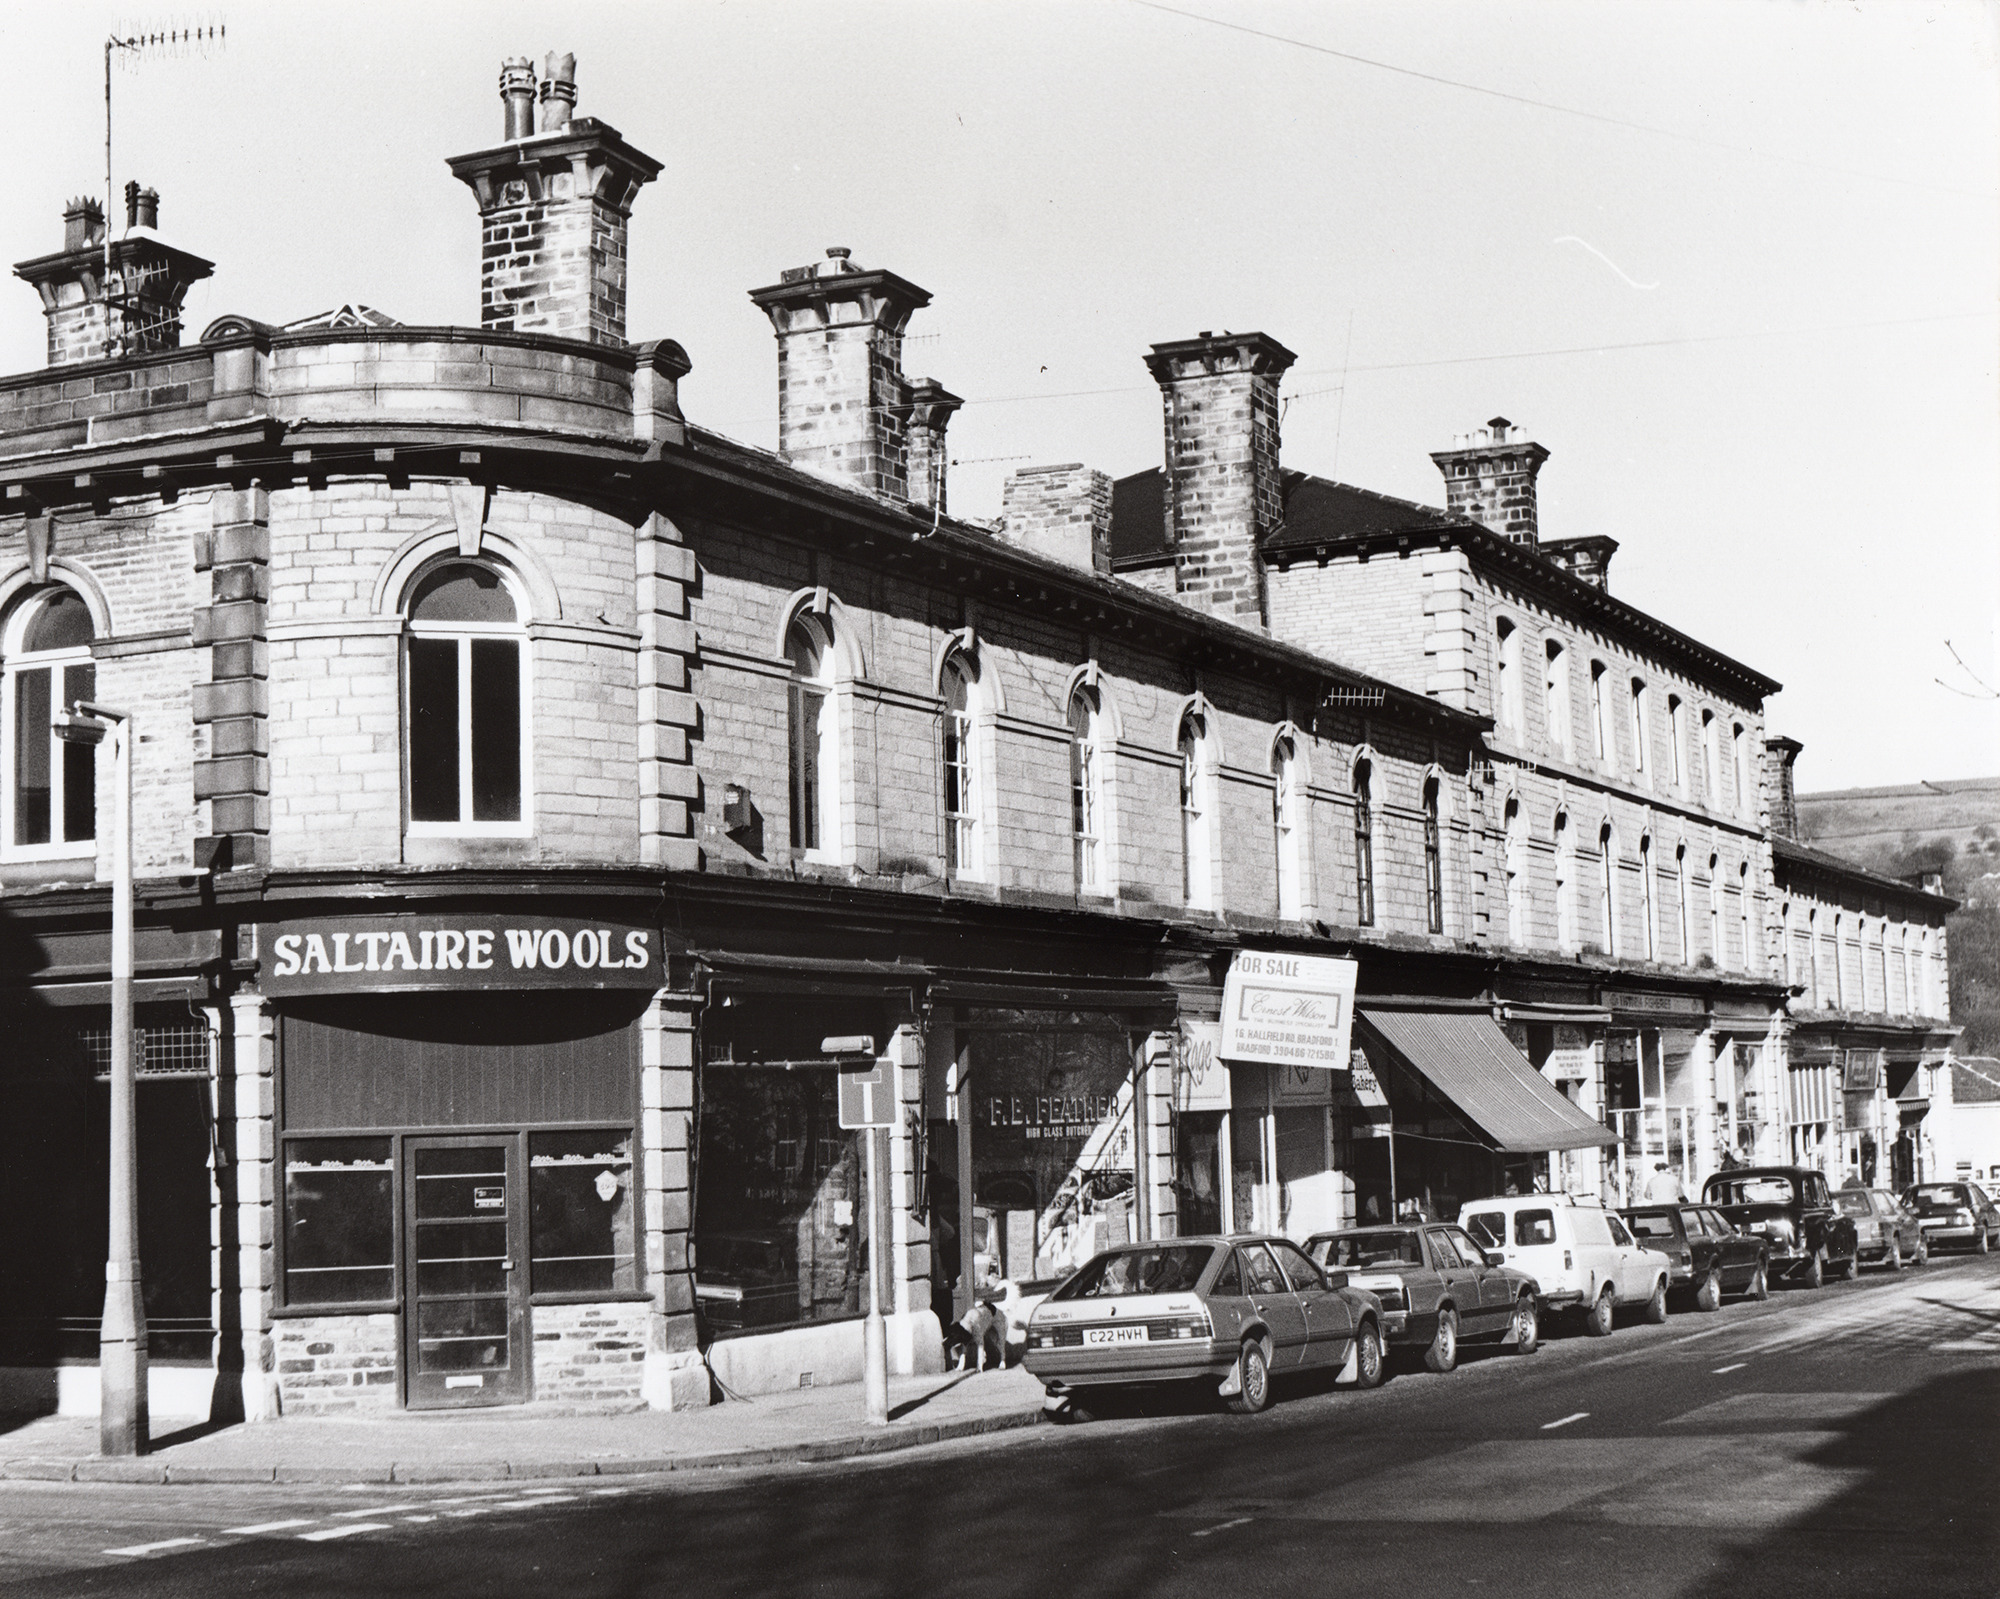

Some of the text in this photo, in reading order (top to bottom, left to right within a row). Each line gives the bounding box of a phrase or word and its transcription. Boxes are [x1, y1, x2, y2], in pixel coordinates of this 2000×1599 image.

[274, 928, 649, 977] SALTAIRE WOOLS
[1234, 956, 1262, 974] FOR
[1266, 958, 1300, 978] SALE
[1250, 993, 1327, 1020] Ernest Wilson
[1236, 1042, 1271, 1055] BRADFORD
[1297, 1033, 1333, 1047] BRADFORD
[1036, 1094, 1119, 1125] FEATHER
[1026, 1127, 1040, 1138] HIGH
[1043, 1126, 1063, 1138] CLASS
[1089, 1328, 1142, 1343] C22 HVH
